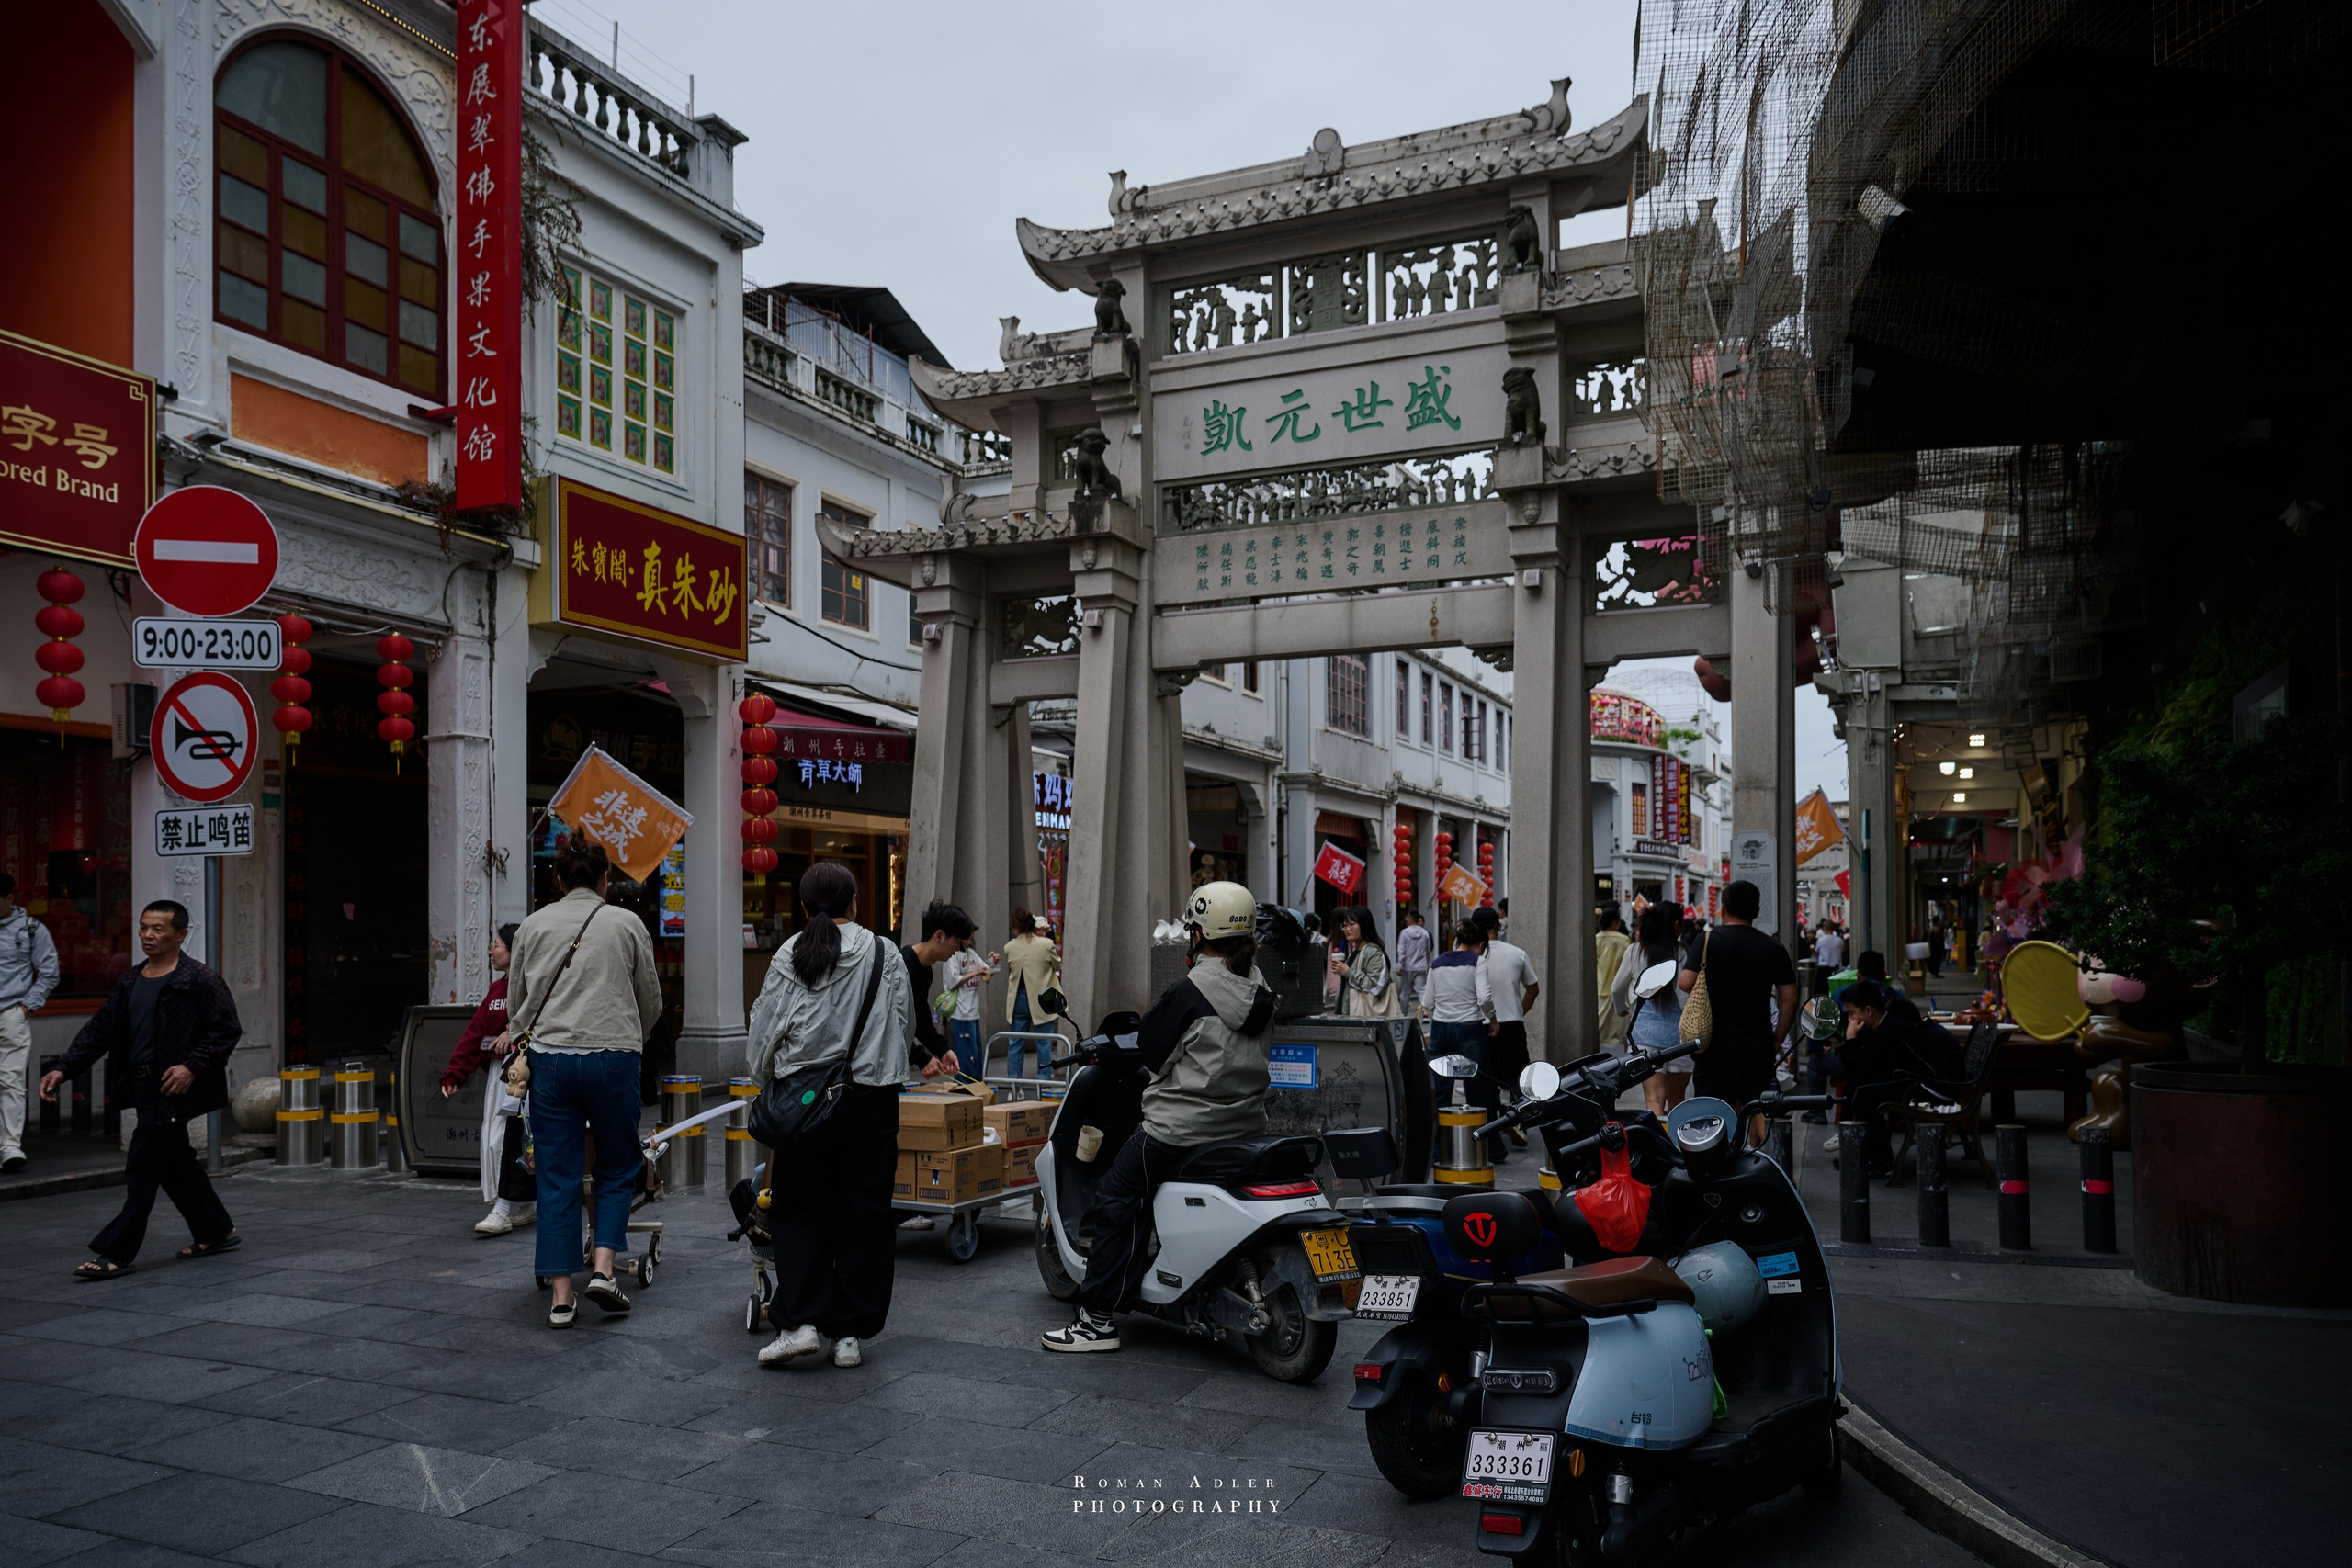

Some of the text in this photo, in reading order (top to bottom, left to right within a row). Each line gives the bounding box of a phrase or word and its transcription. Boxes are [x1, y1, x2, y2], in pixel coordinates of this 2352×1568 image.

[462, 0, 497, 463] 东展翠佛手果文化馆
[1, 404, 119, 469] 字号
[56, 468, 119, 503] Brand
[142, 626, 273, 662] 9:00-23:00
[160, 810, 252, 851] 禁止鸣笛
[1380, 1280, 1400, 1289] 潮州
[1362, 1292, 1411, 1307] 233851
[1497, 1439, 1525, 1451] 潮州
[1472, 1454, 1544, 1477] 333361
[1463, 1483, 1503, 1499] 鑫盛车行
[1503, 1494, 1544, 1503] 13435574089
